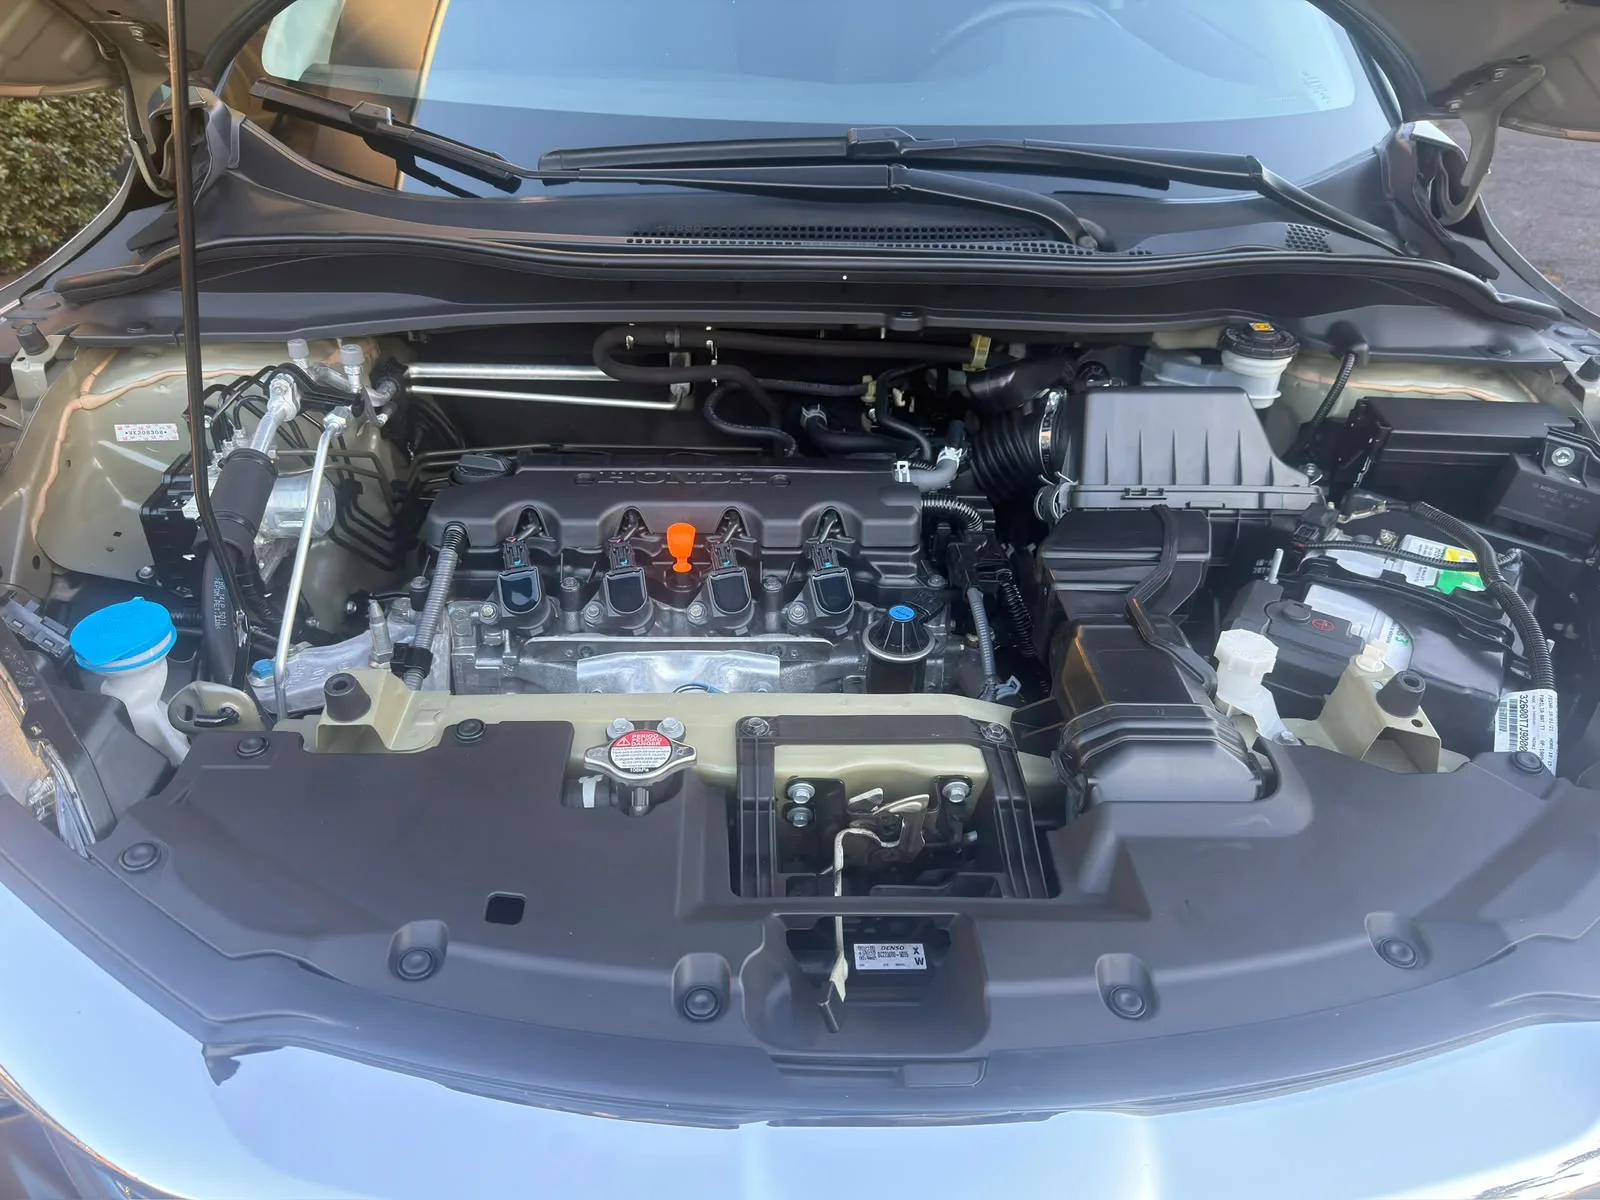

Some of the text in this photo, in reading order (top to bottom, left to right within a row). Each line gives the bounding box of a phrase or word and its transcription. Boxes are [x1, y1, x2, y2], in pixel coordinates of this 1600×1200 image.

[598, 471, 767, 484] HONDA
[912, 946, 920, 955] X
[914, 957, 924, 966] W
